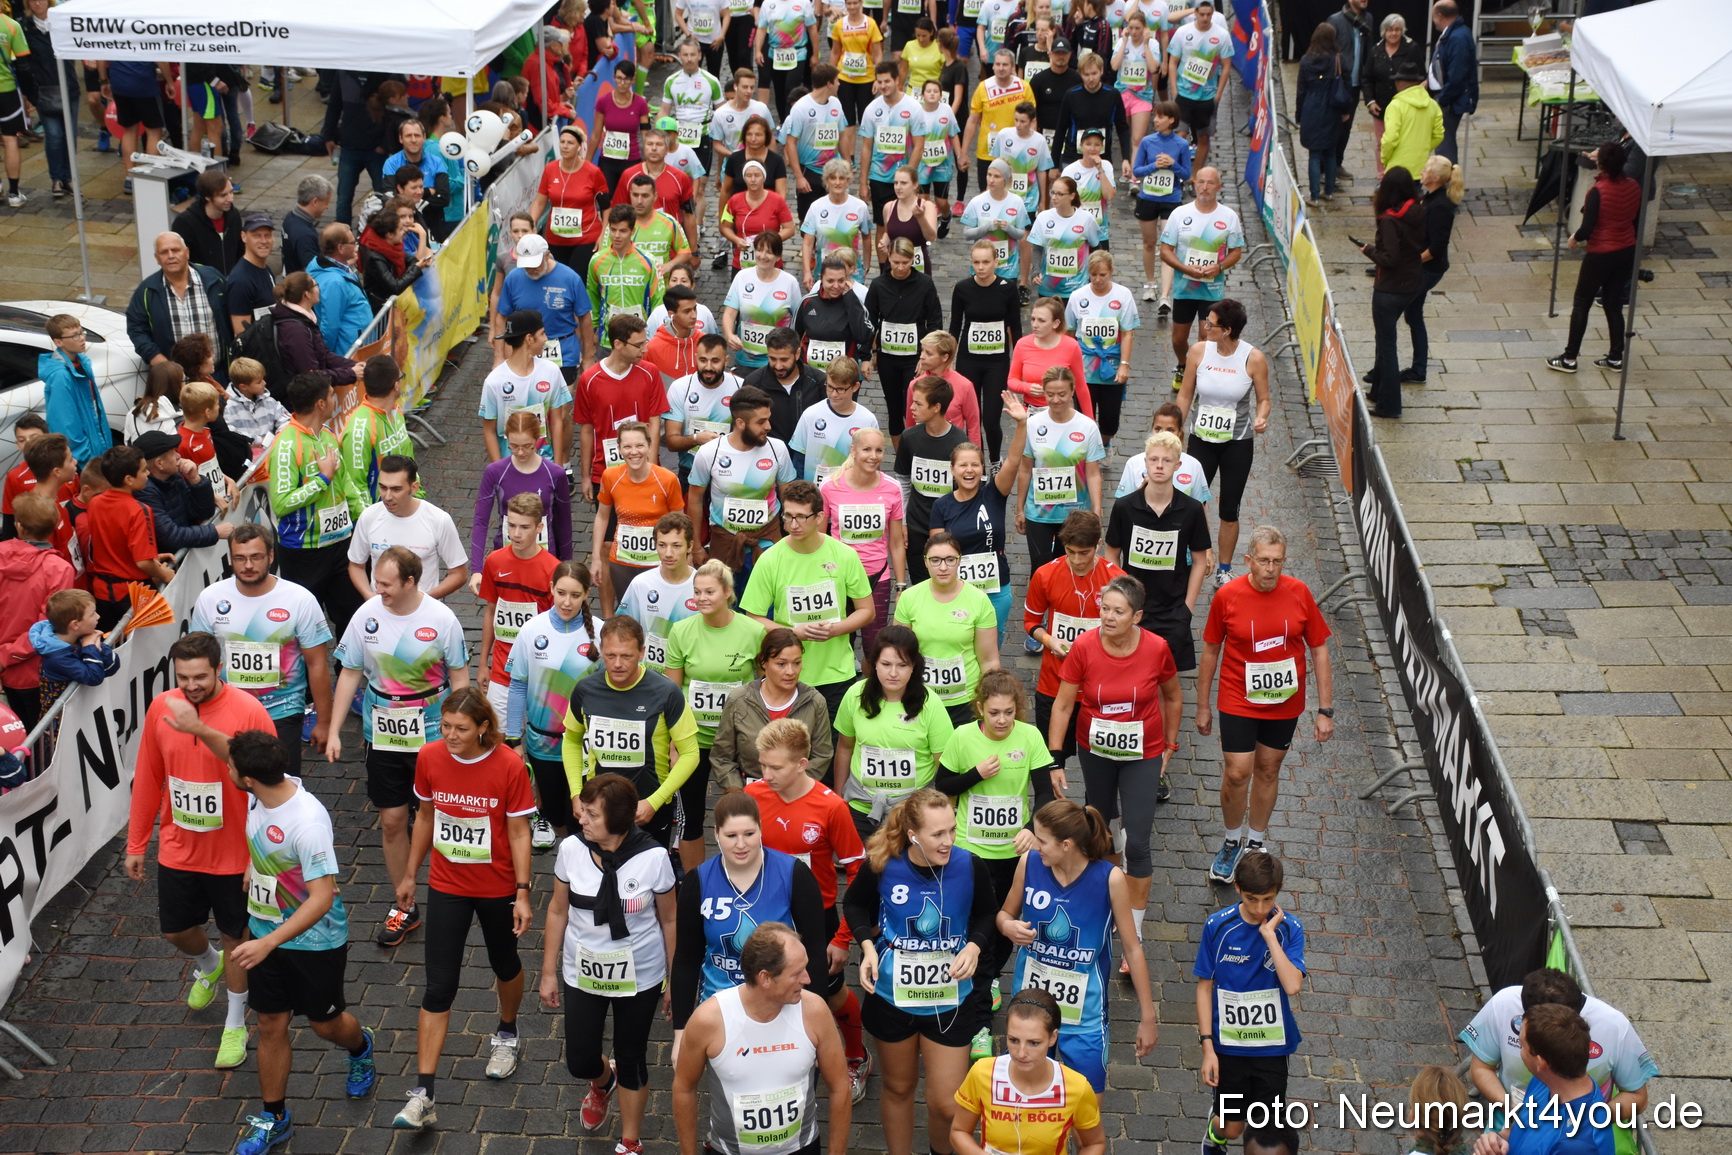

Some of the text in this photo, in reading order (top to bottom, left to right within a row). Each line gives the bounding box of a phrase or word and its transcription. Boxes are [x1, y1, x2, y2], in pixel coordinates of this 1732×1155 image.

[70, 17, 289, 39] BMW ConnectedDrive
[694, 19, 713, 27] 5007
[74, 38, 240, 53] Vernetzt, um frei zu sein.
[777, 53, 796, 61] 5140
[845, 59, 864, 67] 5252
[1124, 67, 1145, 77] 5142
[1186, 61, 1209, 77] 5097
[989, 94, 1026, 108] MAX BÖGL
[818, 130, 837, 140] 5231
[880, 133, 903, 144] 5232
[606, 140, 628, 149] 5304
[922, 147, 944, 158] 5164
[1146, 175, 1171, 187] 5183
[554, 215, 579, 226] 5129
[743, 251, 754, 262] 51
[1050, 255, 1075, 267] 5102
[600, 275, 645, 285] BOCK
[885, 331, 914, 343] 5176
[972, 330, 1002, 342] 5268
[1085, 325, 1115, 337] 5005
[1200, 413, 1231, 431] 5104
[353, 418, 366, 469] BOCK
[277, 440, 293, 494] BOCK
[915, 467, 948, 484] 5191
[1038, 476, 1072, 491] 5174
[324, 510, 348, 534] 2869
[728, 508, 764, 524] 5202
[844, 515, 881, 529] 5093
[622, 535, 656, 551] 5090
[1135, 537, 1174, 556] 5277
[630, 553, 647, 561] Maria
[959, 562, 995, 580] 5132
[791, 594, 835, 614] 5194
[269, 610, 289, 620] Hervis
[807, 612, 822, 622] Alex
[417, 630, 436, 639] Hervis
[1263, 640, 1276, 648] DEHN
[648, 645, 665, 663] 53
[231, 653, 273, 671] 5081
[240, 674, 265, 683] Patrick
[922, 667, 961, 684] 5190
[1252, 670, 1294, 690] 5084
[1263, 690, 1283, 698] Frank
[378, 717, 420, 735] 5064
[389, 738, 409, 746] Andre
[594, 730, 639, 750] 5156
[1095, 731, 1138, 750] 5085
[601, 753, 631, 761] Andreas
[867, 758, 911, 777] 5119
[875, 780, 901, 788] Larissa
[174, 789, 217, 815] 5116
[182, 814, 205, 826] Daniel
[973, 807, 1018, 826] 5068
[440, 821, 486, 844] 5047
[981, 830, 1009, 838] Tamara
[451, 847, 472, 858] Anita
[891, 884, 909, 904] 8
[1025, 886, 1051, 910] 10
[700, 897, 733, 921] 45
[597, 949, 628, 959] BOCK
[1041, 957, 1070, 967] BASKETS
[581, 959, 628, 980] 5077
[900, 963, 952, 985] 5028
[592, 981, 620, 991] Christa
[1029, 973, 1080, 1005] 5138
[907, 989, 944, 999] Christina
[1244, 992, 1274, 1001] BOCK
[1225, 1003, 1277, 1026] 5020
[1237, 1030, 1266, 1040] Yannik
[753, 1043, 799, 1054] KLEBL
[765, 1087, 796, 1103] BOCK
[743, 1099, 799, 1131] 5015
[991, 1110, 1066, 1123] MAX BÖGL
[757, 1130, 789, 1143] Roland
